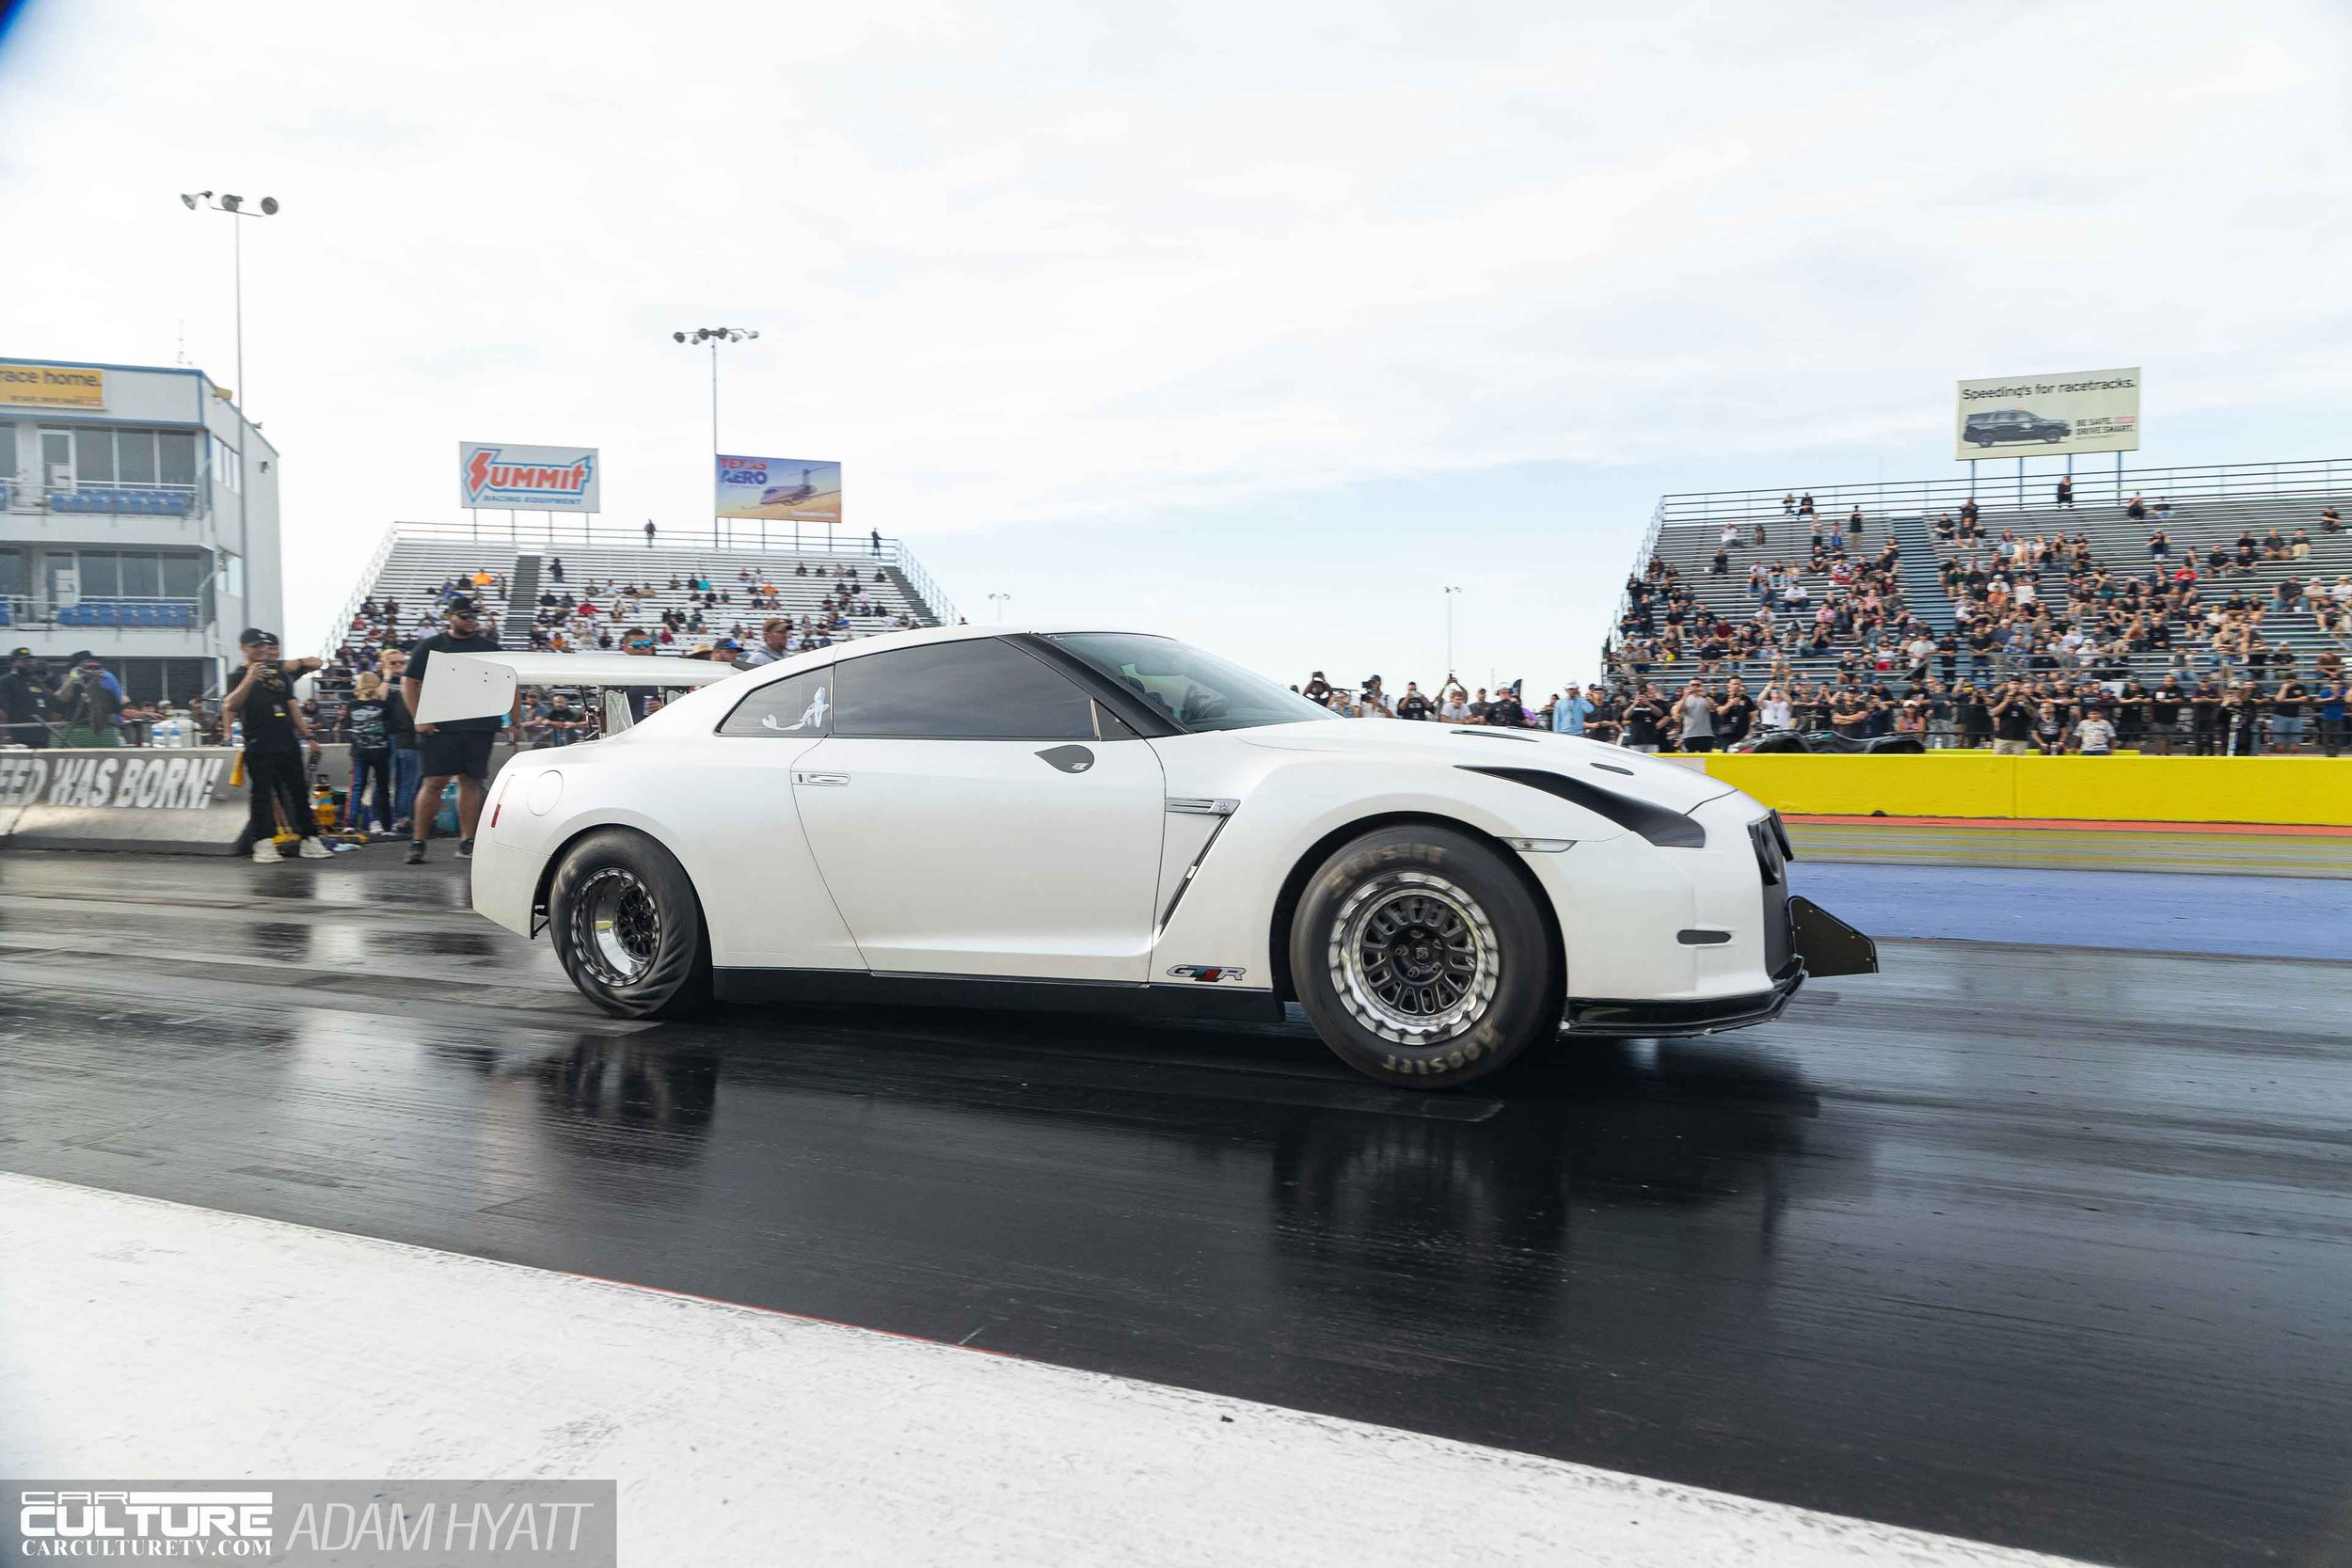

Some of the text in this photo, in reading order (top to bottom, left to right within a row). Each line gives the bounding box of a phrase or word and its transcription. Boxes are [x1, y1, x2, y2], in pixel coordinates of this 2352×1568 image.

[1962, 385, 2032, 401] Speeding's
[2035, 384, 2055, 395] for
[721, 457, 768, 471] TEXAS
[721, 469, 769, 485] AERO
[483, 495, 583, 506] RACING EQUIPMENT
[48, 758, 119, 807] WAS
[113, 758, 225, 810] BORN!
